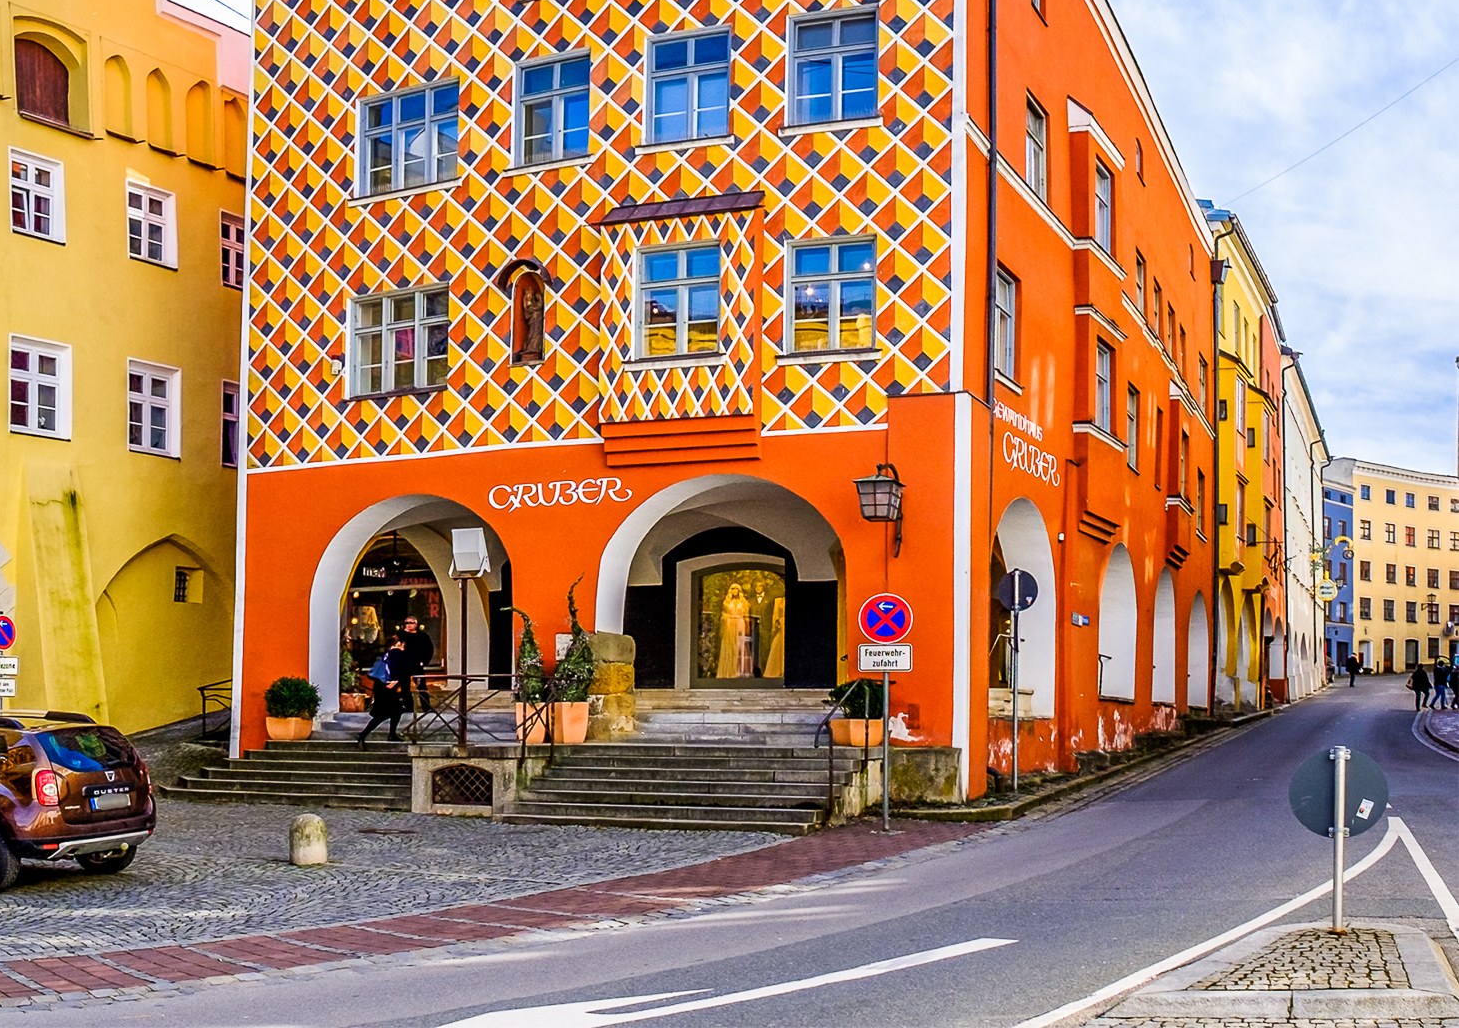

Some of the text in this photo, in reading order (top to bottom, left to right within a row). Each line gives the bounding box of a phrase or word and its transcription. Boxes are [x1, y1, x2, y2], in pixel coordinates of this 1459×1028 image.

[1003, 431, 1061, 487] GRUBER
[488, 477, 633, 513] GRUBER
[864, 648, 906, 657] Feuerwehr-
[872, 659, 898, 667] zufahrt
[93, 787, 130, 795] DUSTER
